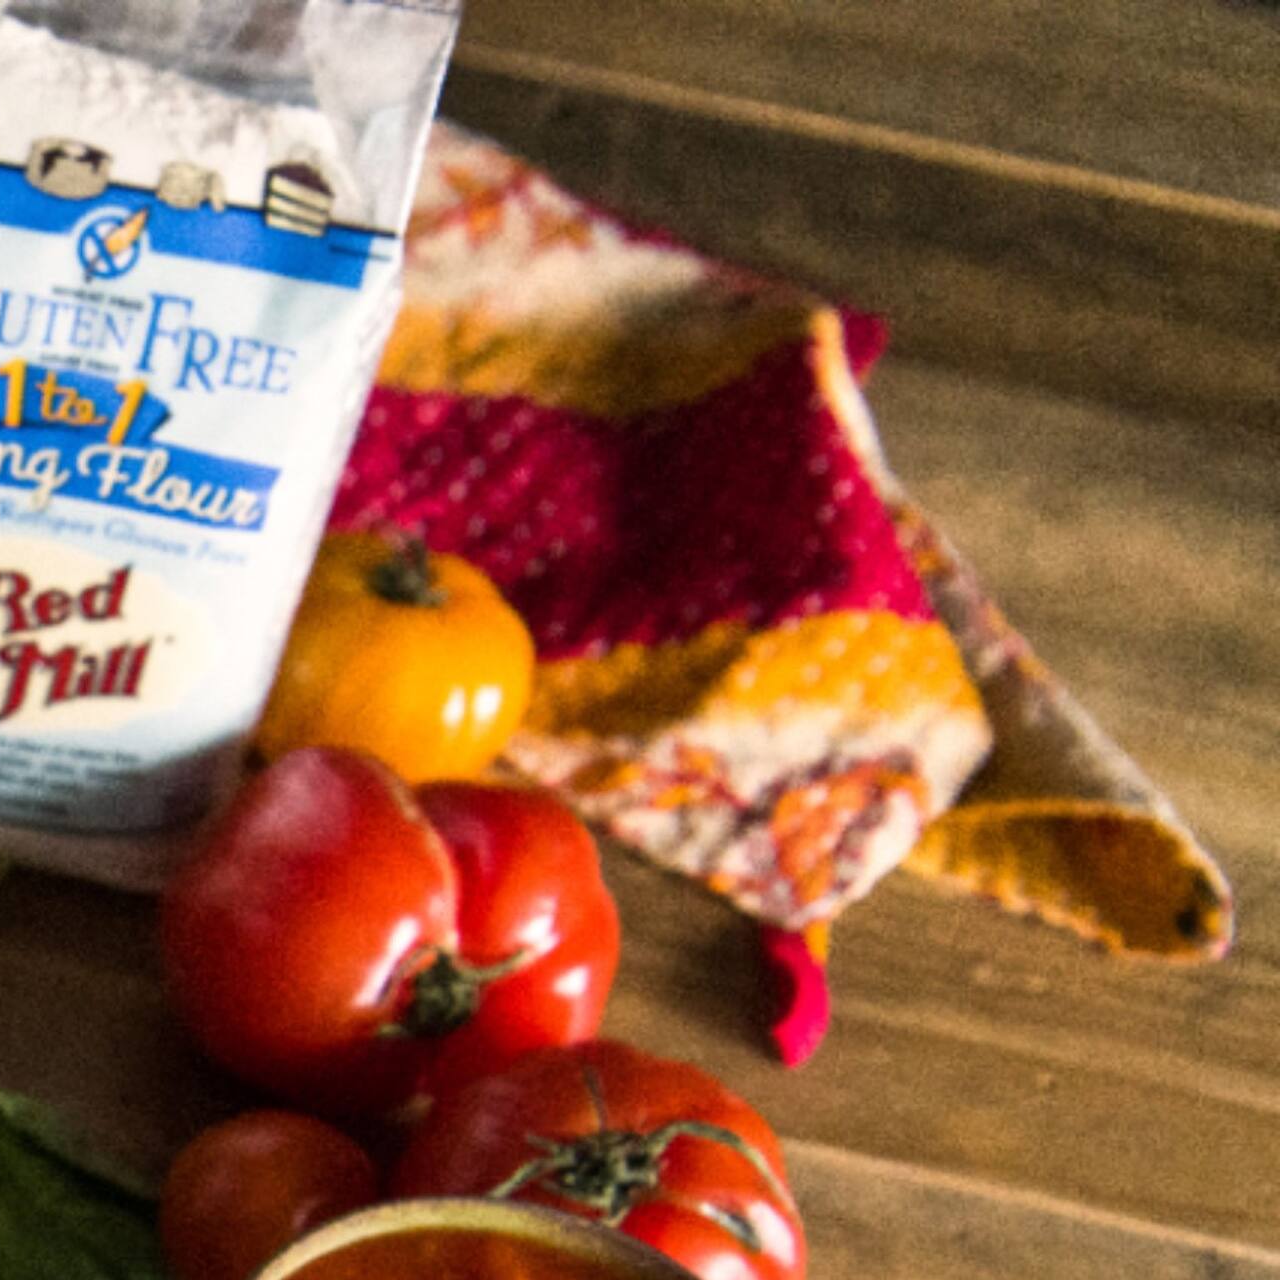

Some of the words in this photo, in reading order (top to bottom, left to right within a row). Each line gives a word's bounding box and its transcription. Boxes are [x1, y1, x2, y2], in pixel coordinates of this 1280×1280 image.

[135, 292, 298, 393] FREE
[36, 370, 108, 426] to
[108, 379, 149, 446] 1
[77, 443, 261, 526] Flour
